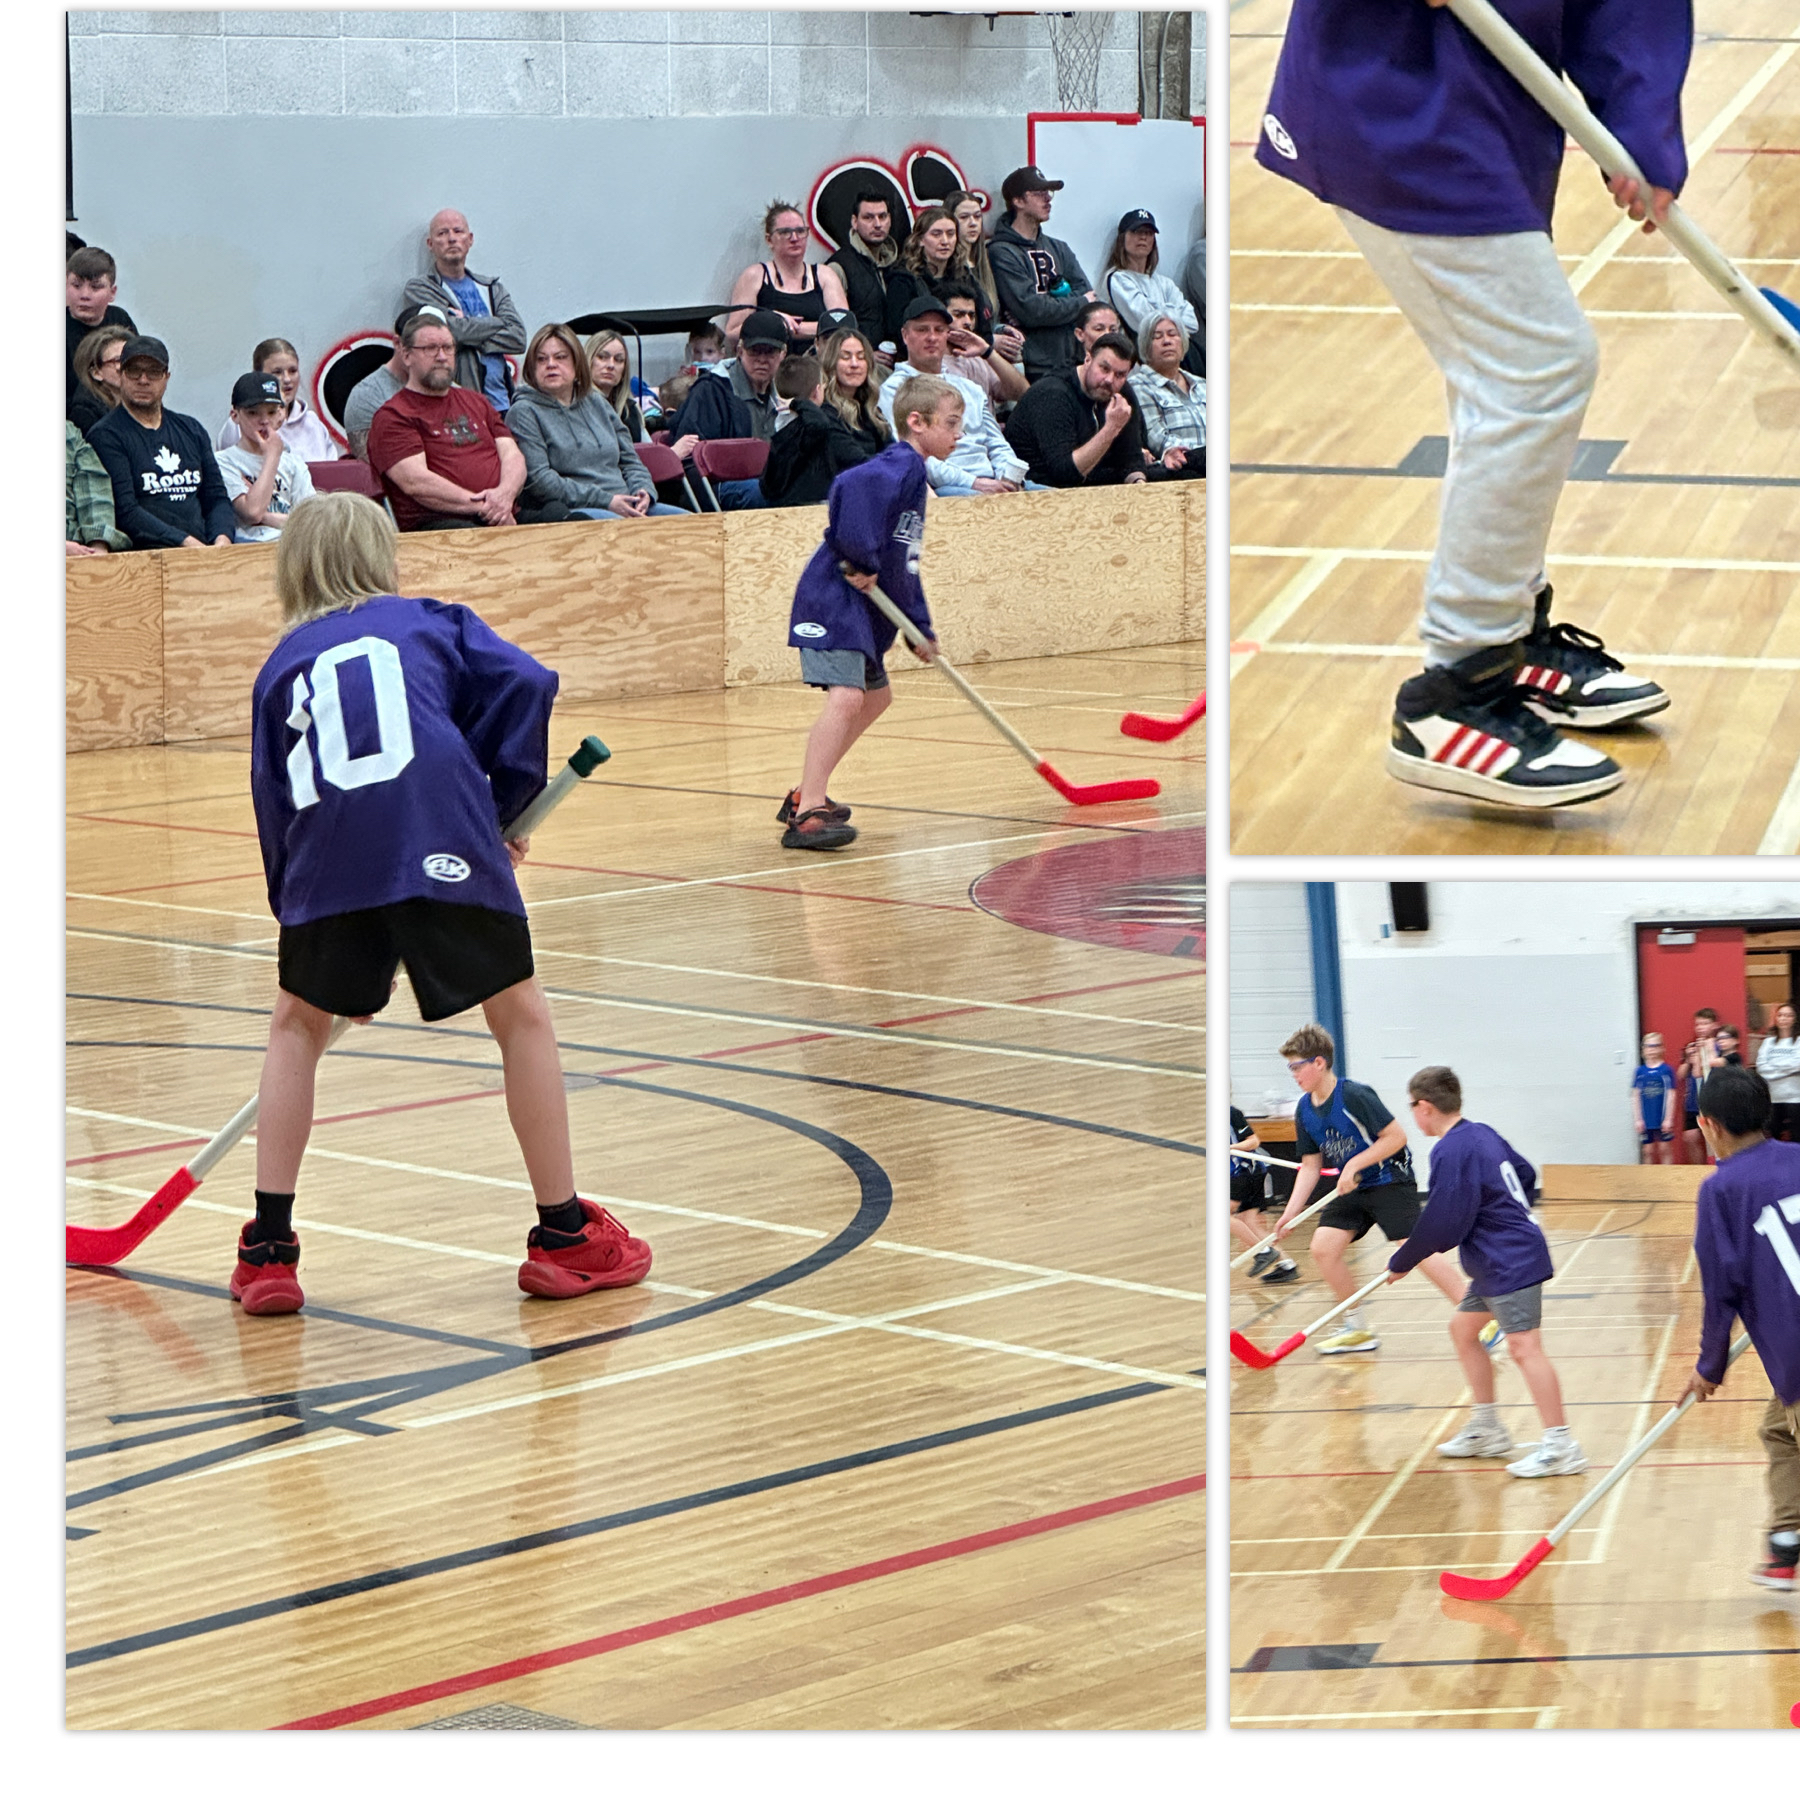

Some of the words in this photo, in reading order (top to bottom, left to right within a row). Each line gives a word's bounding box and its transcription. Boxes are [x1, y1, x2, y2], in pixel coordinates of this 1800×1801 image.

[1028, 250, 1057, 294] R
[141, 469, 201, 492] Roots
[285, 636, 416, 811] 10
